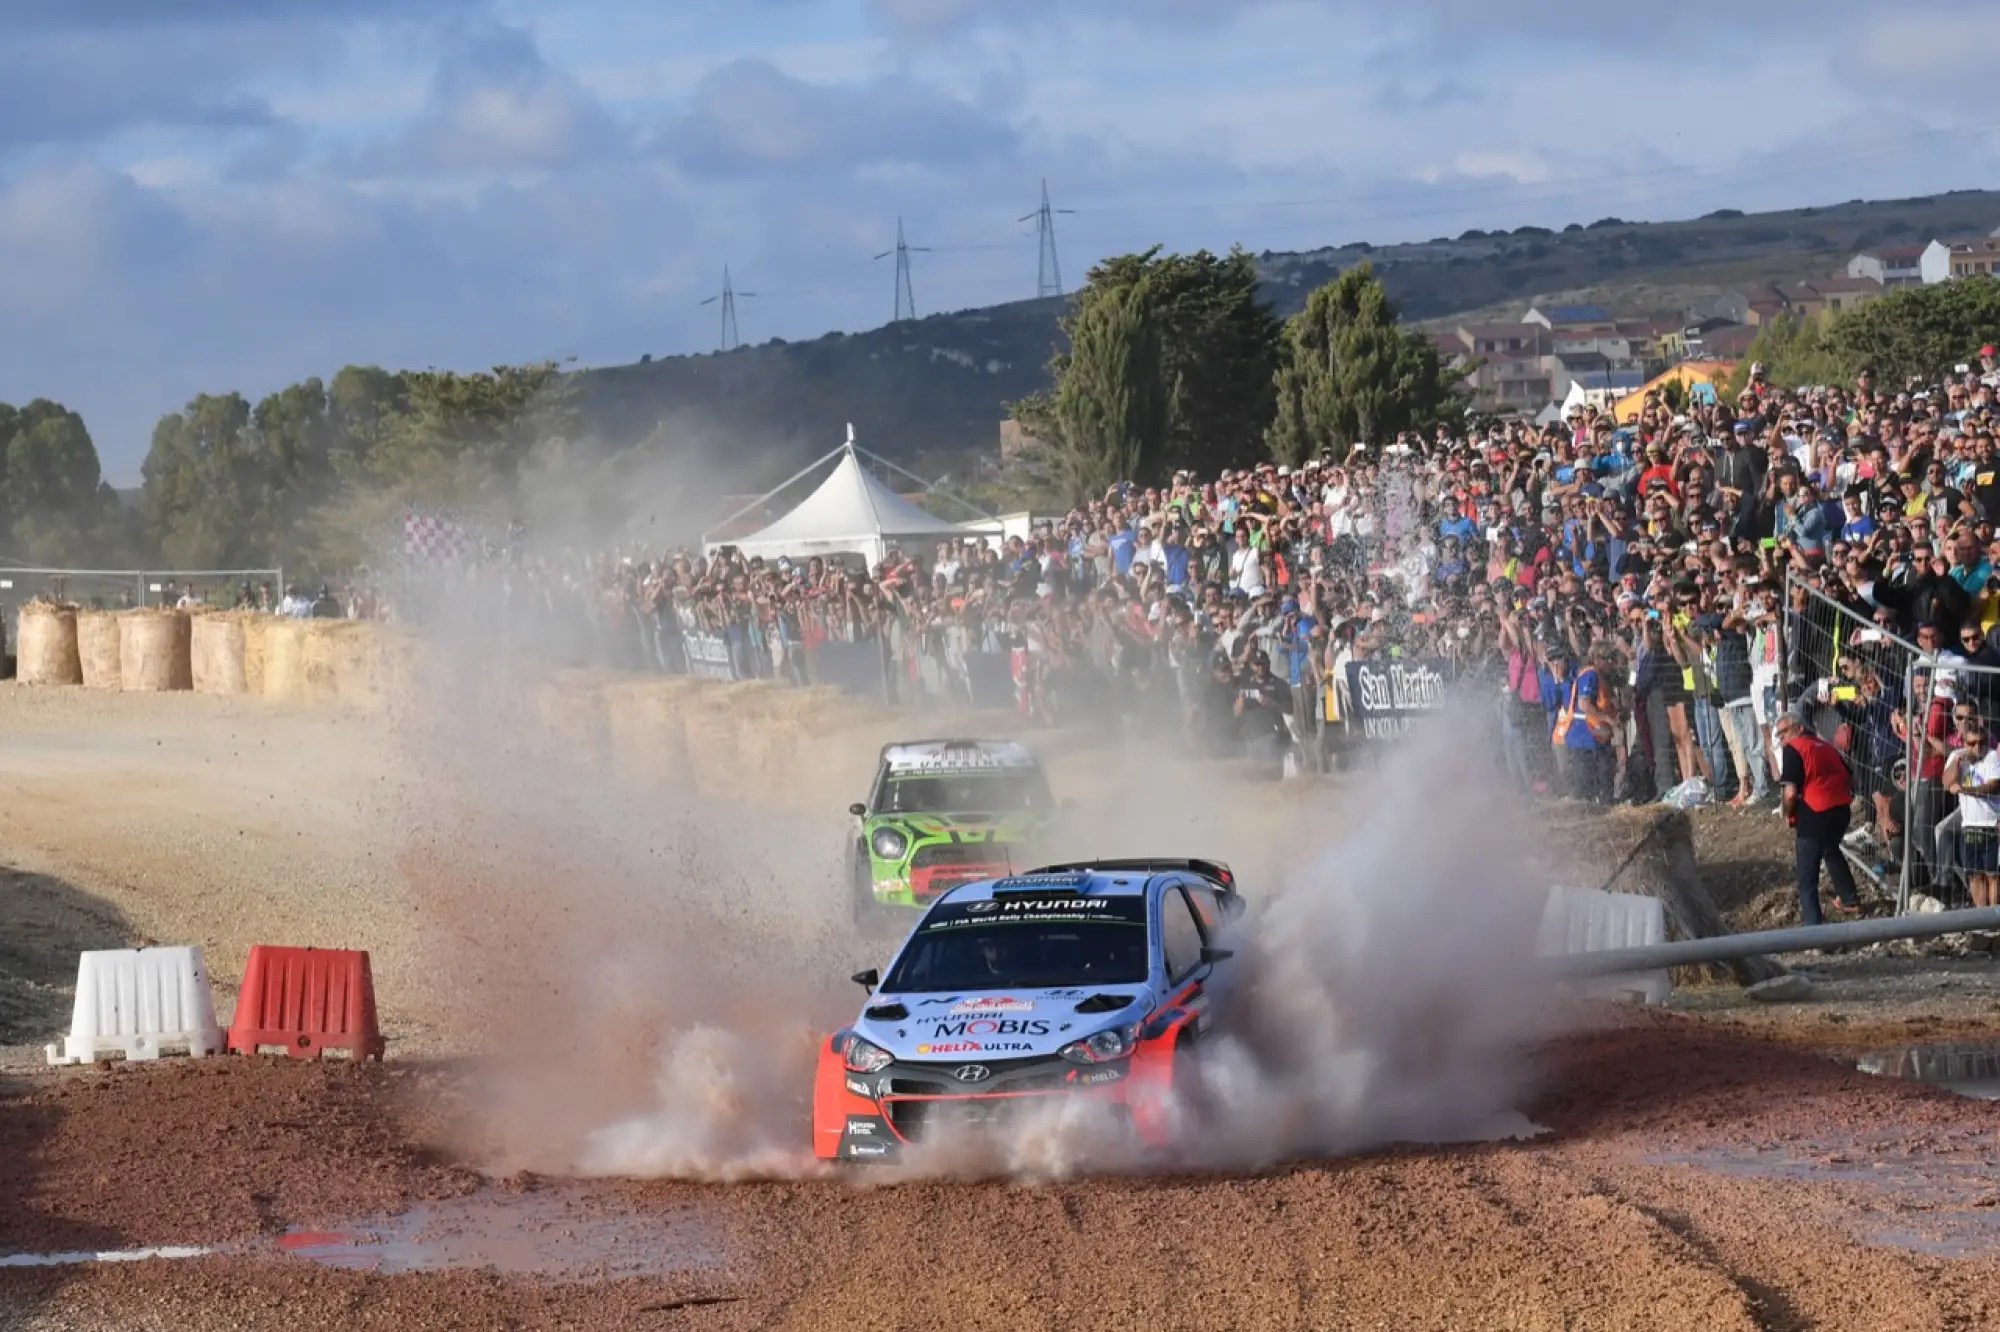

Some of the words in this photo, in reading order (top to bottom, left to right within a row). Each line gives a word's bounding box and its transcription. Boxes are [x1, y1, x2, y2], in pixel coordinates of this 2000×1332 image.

[1359, 665, 1391, 710] San
[1390, 664, 1445, 710] Martino
[1004, 899, 1108, 911] HYUNDAI
[972, 916, 997, 924] World
[1023, 912, 1085, 920] Championship
[917, 1012, 1003, 1024] HYUNDAI
[934, 1019, 1050, 1038] MOBIS
[931, 1040, 983, 1053] HELIX
[984, 1042, 1033, 1051] ULTRA
